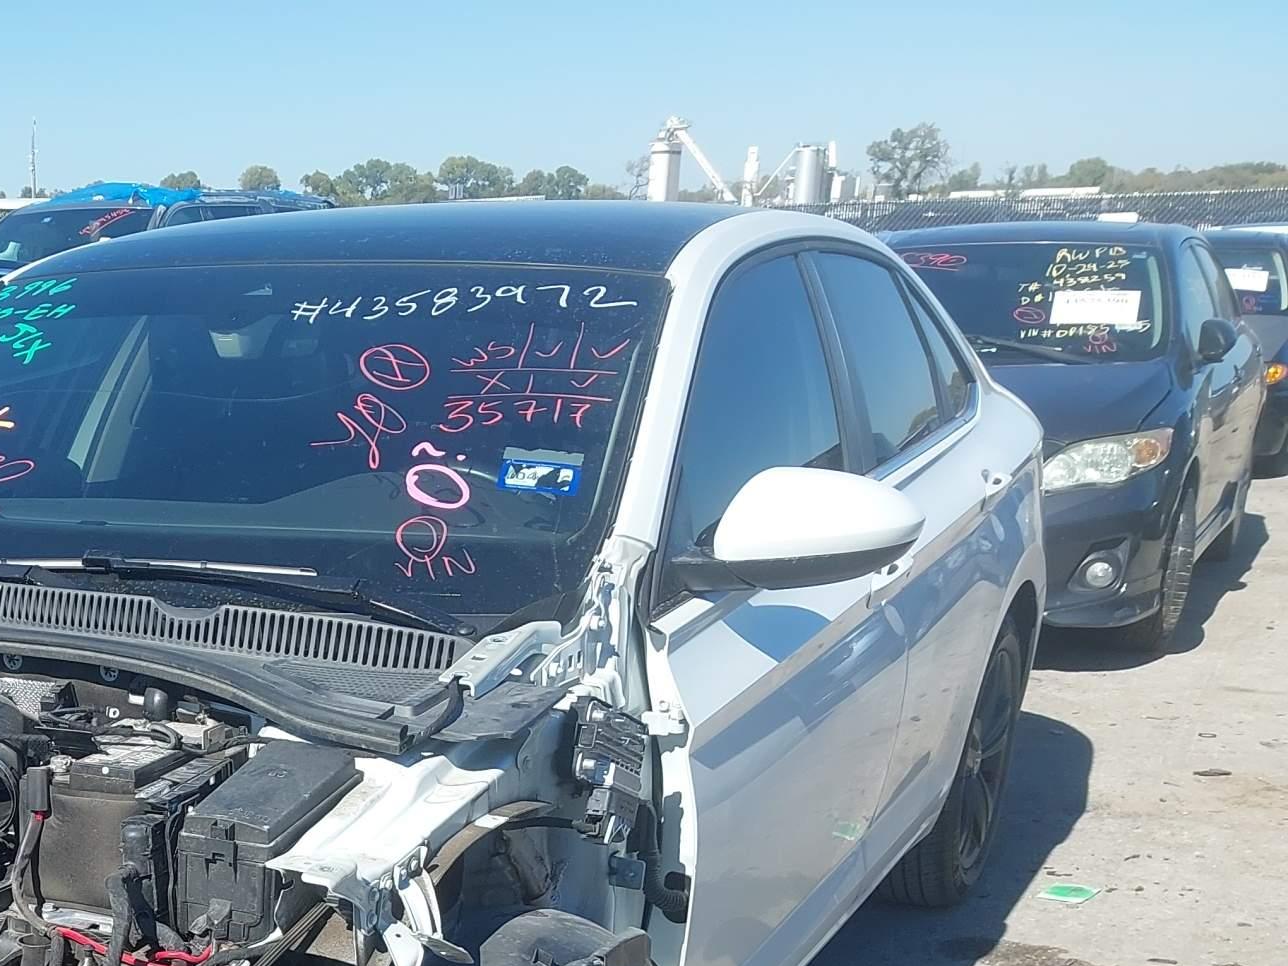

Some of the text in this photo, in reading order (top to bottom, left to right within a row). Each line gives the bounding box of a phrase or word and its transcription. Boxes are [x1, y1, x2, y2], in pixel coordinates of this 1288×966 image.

[290, 284, 638, 324] #43583972
[439, 398, 592, 433] 35717
[393, 549, 476, 580] VIN
